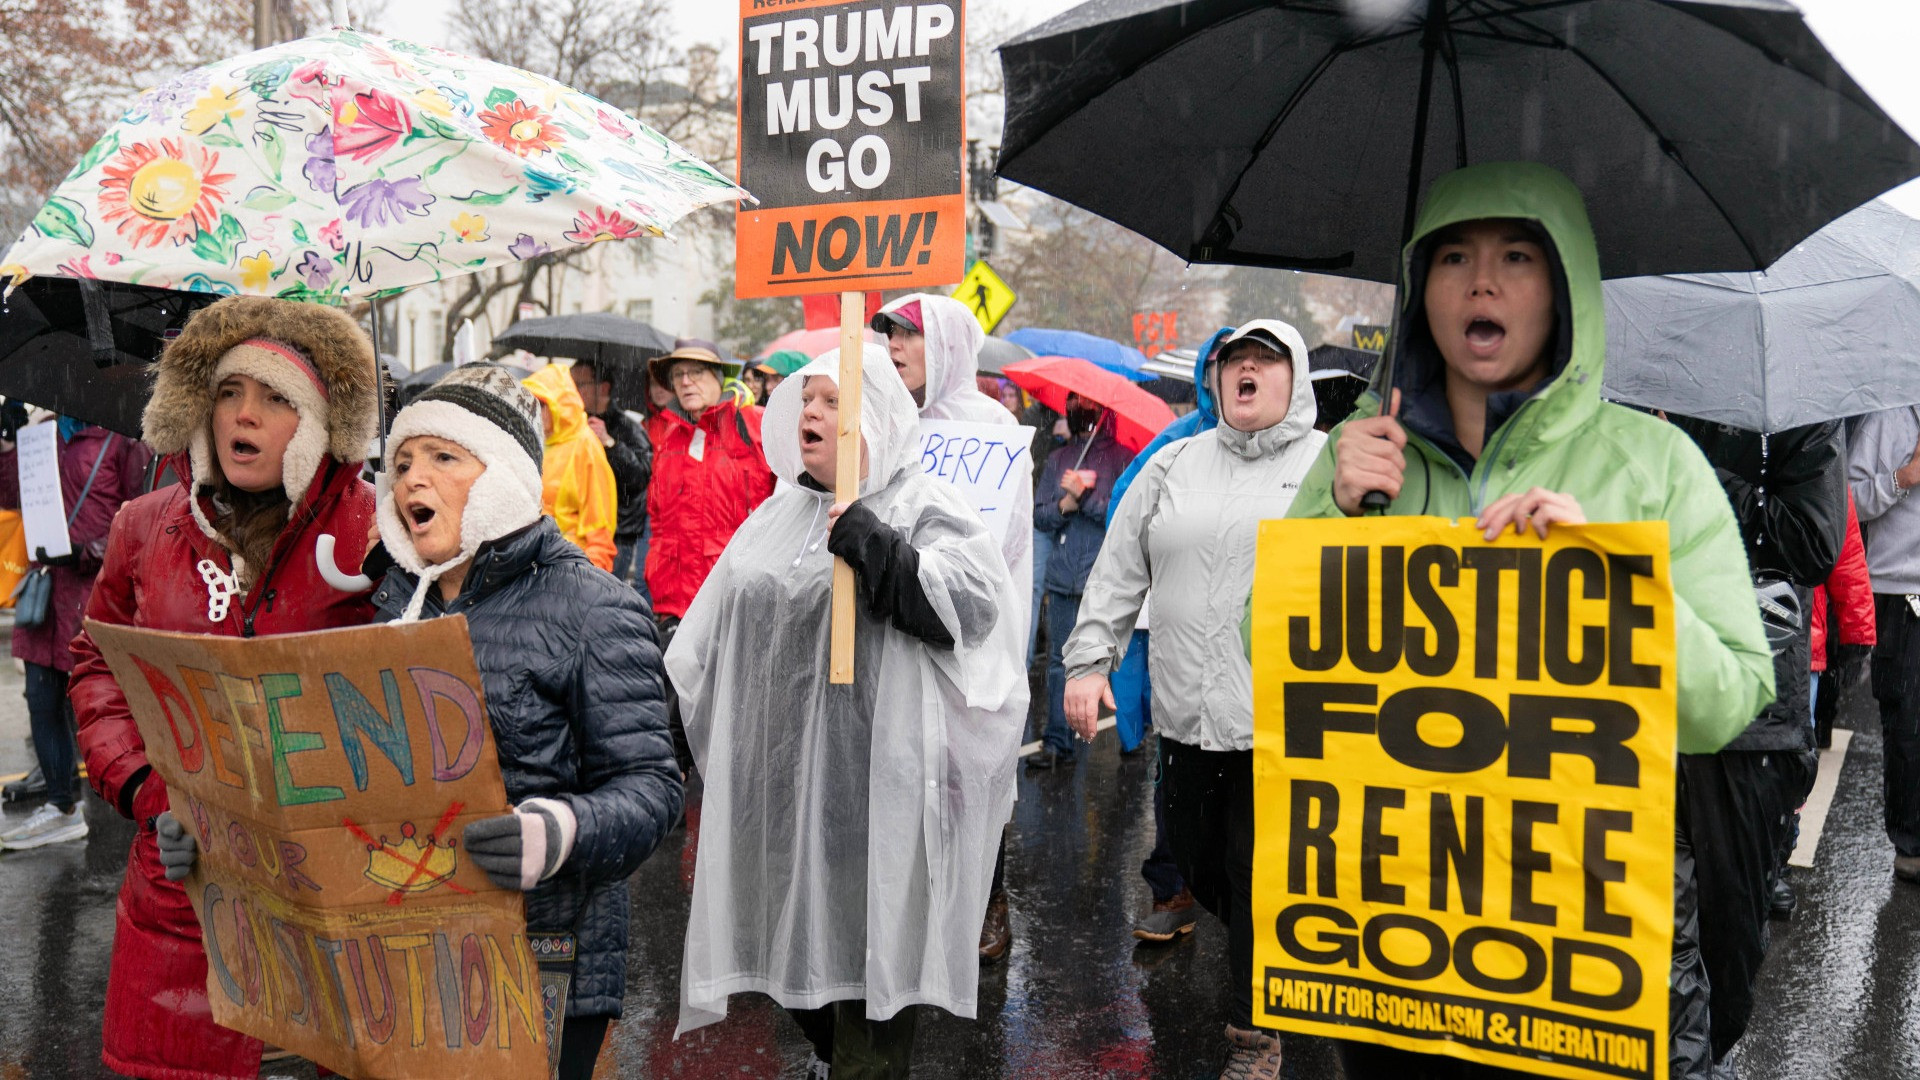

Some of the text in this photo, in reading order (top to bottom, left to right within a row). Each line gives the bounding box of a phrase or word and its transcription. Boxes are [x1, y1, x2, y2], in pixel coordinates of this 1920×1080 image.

[749, 3, 955, 75] TRUMP
[766, 66, 931, 135] MUST
[806, 134, 891, 193] GO
[771, 211, 938, 275] NOW!
[920, 433, 1026, 490] BERTY
[1288, 544, 1661, 689] JUSTICE
[127, 653, 484, 809] DEFEND
[1283, 681, 1641, 788] FOR
[1287, 778, 1632, 938] RENEE
[204, 883, 540, 1050] CONSTITUTION
[1274, 902, 1643, 1011] GOOD
[1268, 977, 1648, 1073] PARTY FOR SOCIALISM & LIBERATION
